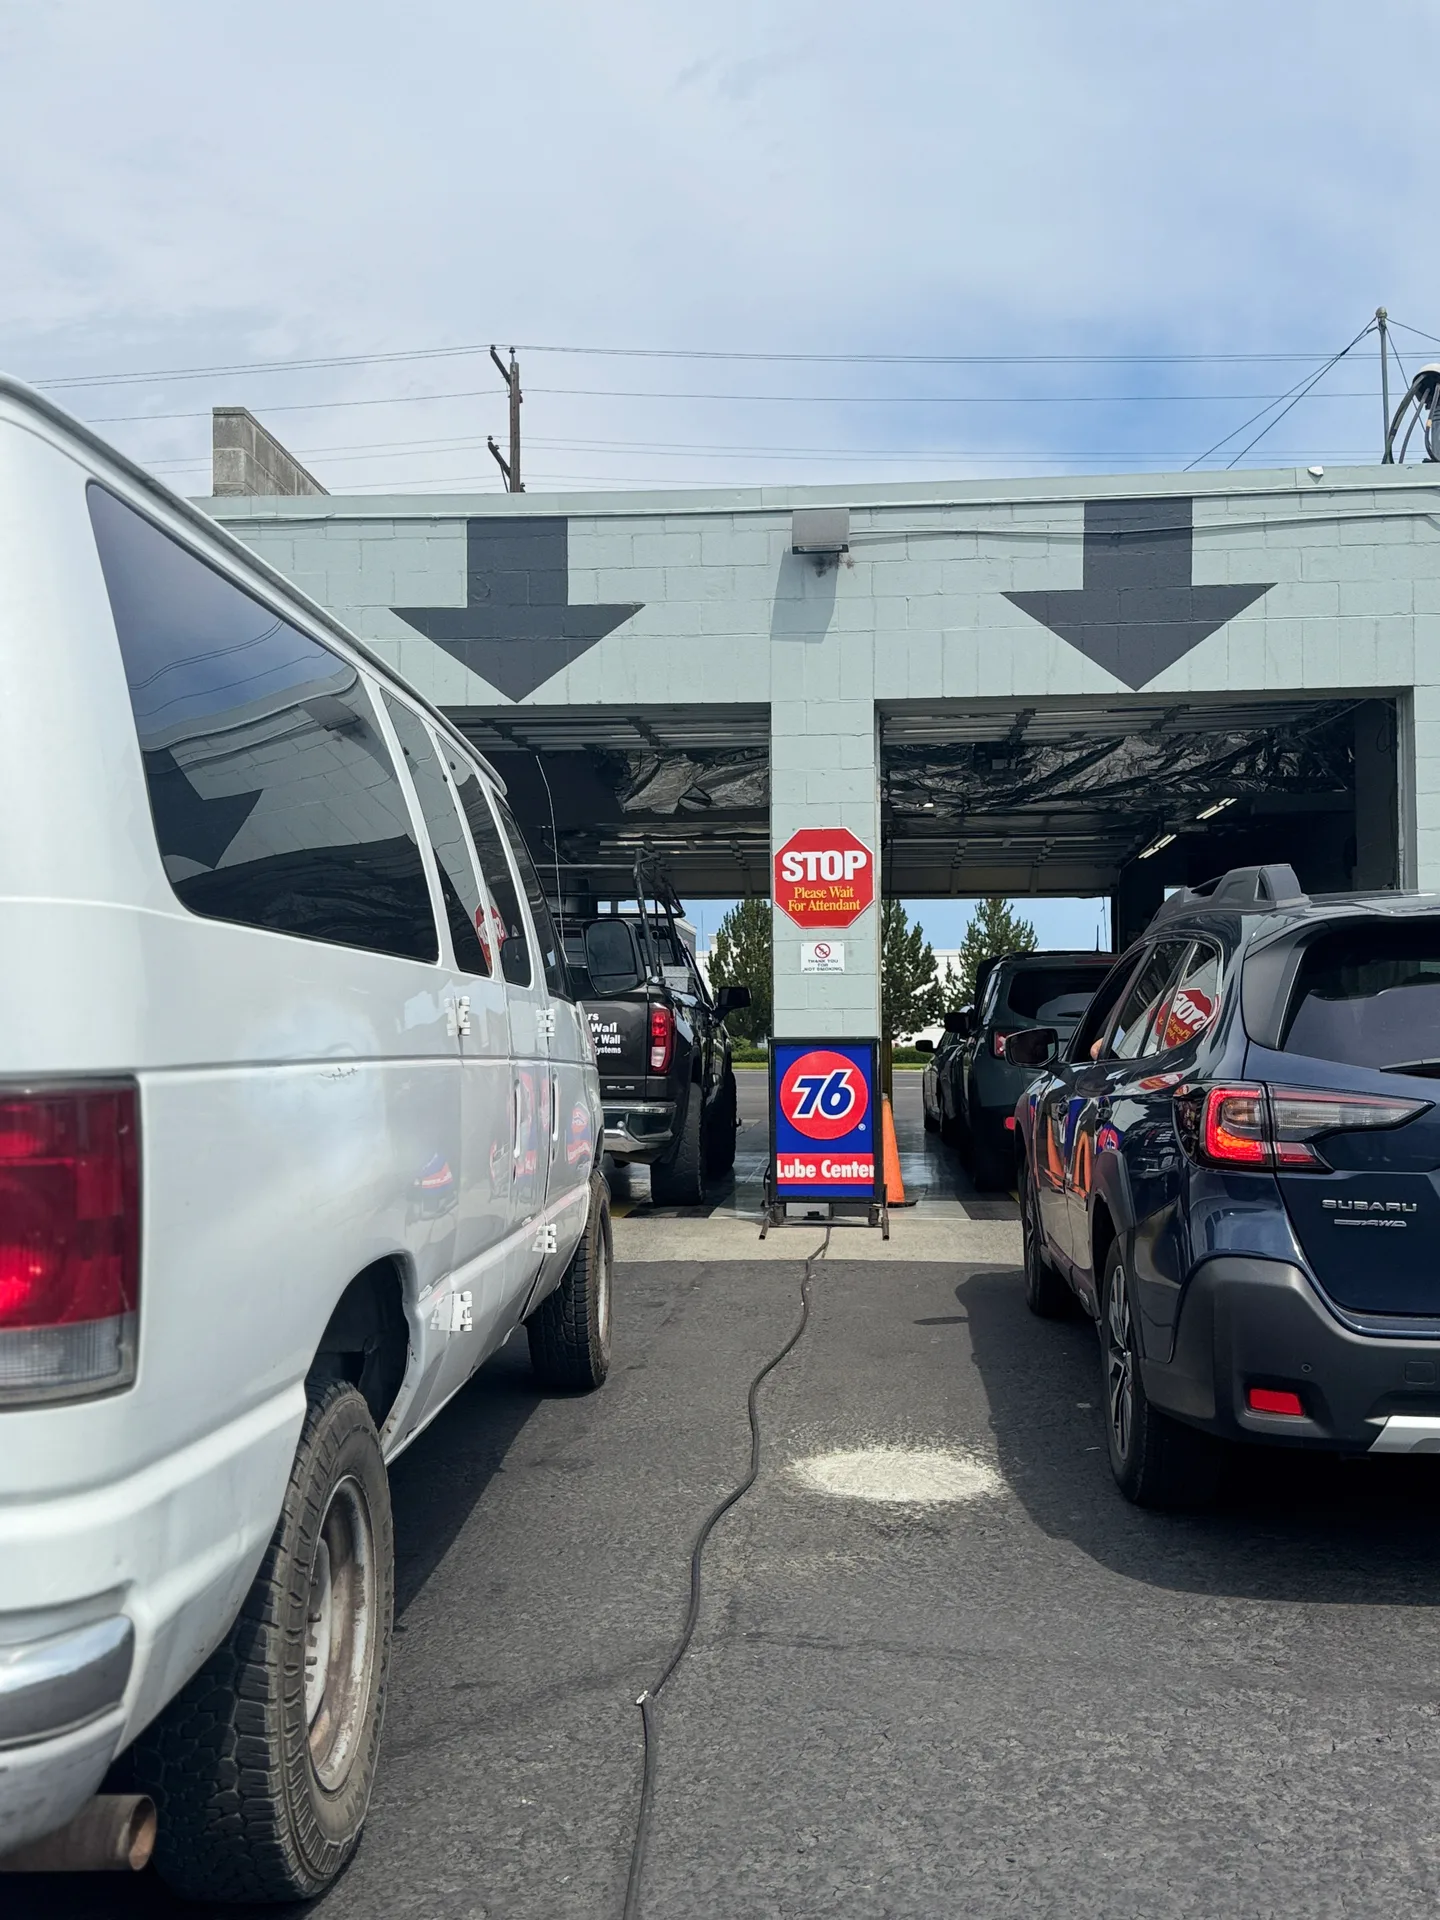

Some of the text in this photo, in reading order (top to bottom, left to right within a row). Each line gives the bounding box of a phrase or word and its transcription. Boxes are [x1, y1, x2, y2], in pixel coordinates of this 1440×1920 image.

[781, 850, 867, 882] STOP
[793, 885, 854, 899] Please Wait
[788, 898, 861, 912] For Attendant
[601, 1034, 621, 1044] Wall
[791, 1068, 856, 1120] 76
[776, 1158, 875, 1179] Lube Center
[1321, 1199, 1418, 1213] SUBARU
